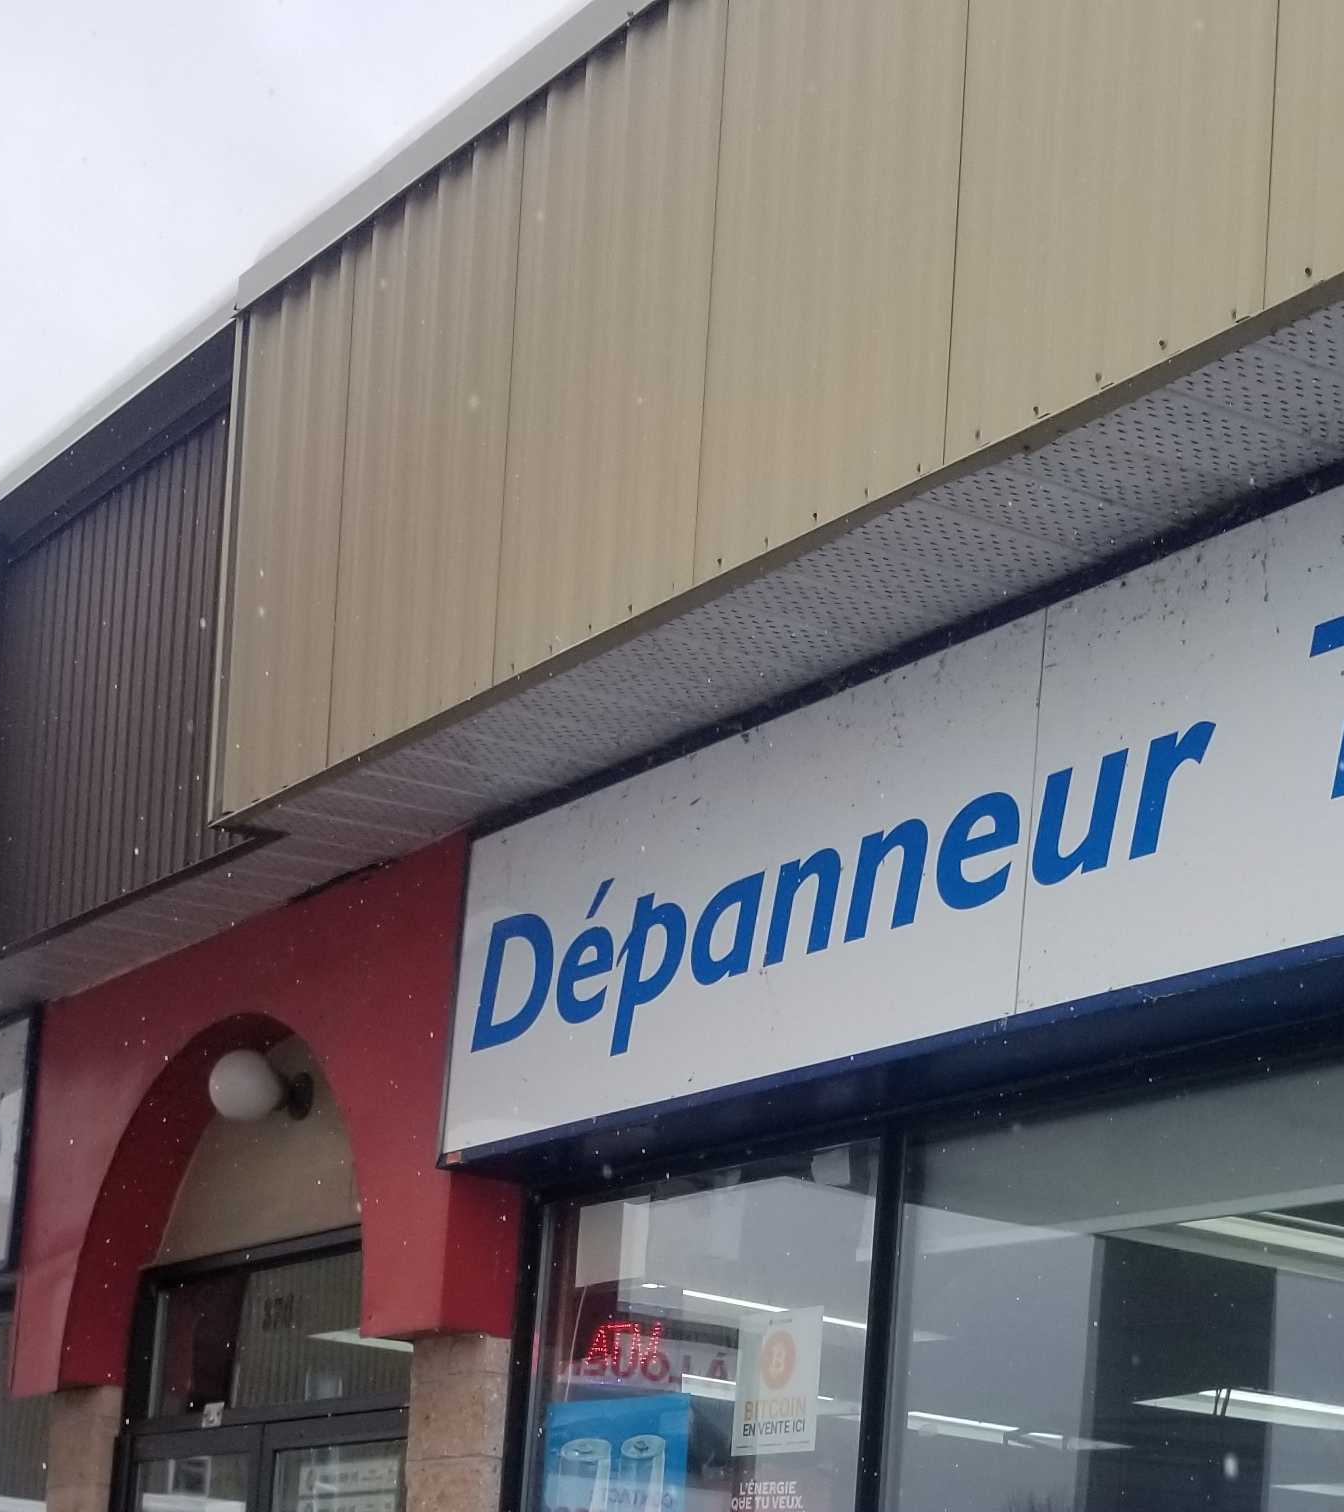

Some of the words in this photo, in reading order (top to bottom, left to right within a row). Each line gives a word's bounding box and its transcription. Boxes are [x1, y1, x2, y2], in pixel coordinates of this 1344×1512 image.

[470, 720, 1218, 1057] Dépanneur
[586, 1320, 663, 1368] ATM
[743, 1396, 807, 1424] BITCOIN
[743, 1423, 756, 1437] EN
[758, 1419, 789, 1435] VENTE
[792, 1418, 805, 1433] ICI
[739, 1479, 797, 1495] L'ÉNERGIE
[731, 1497, 752, 1511] QUE
[754, 1497, 770, 1510] TU
